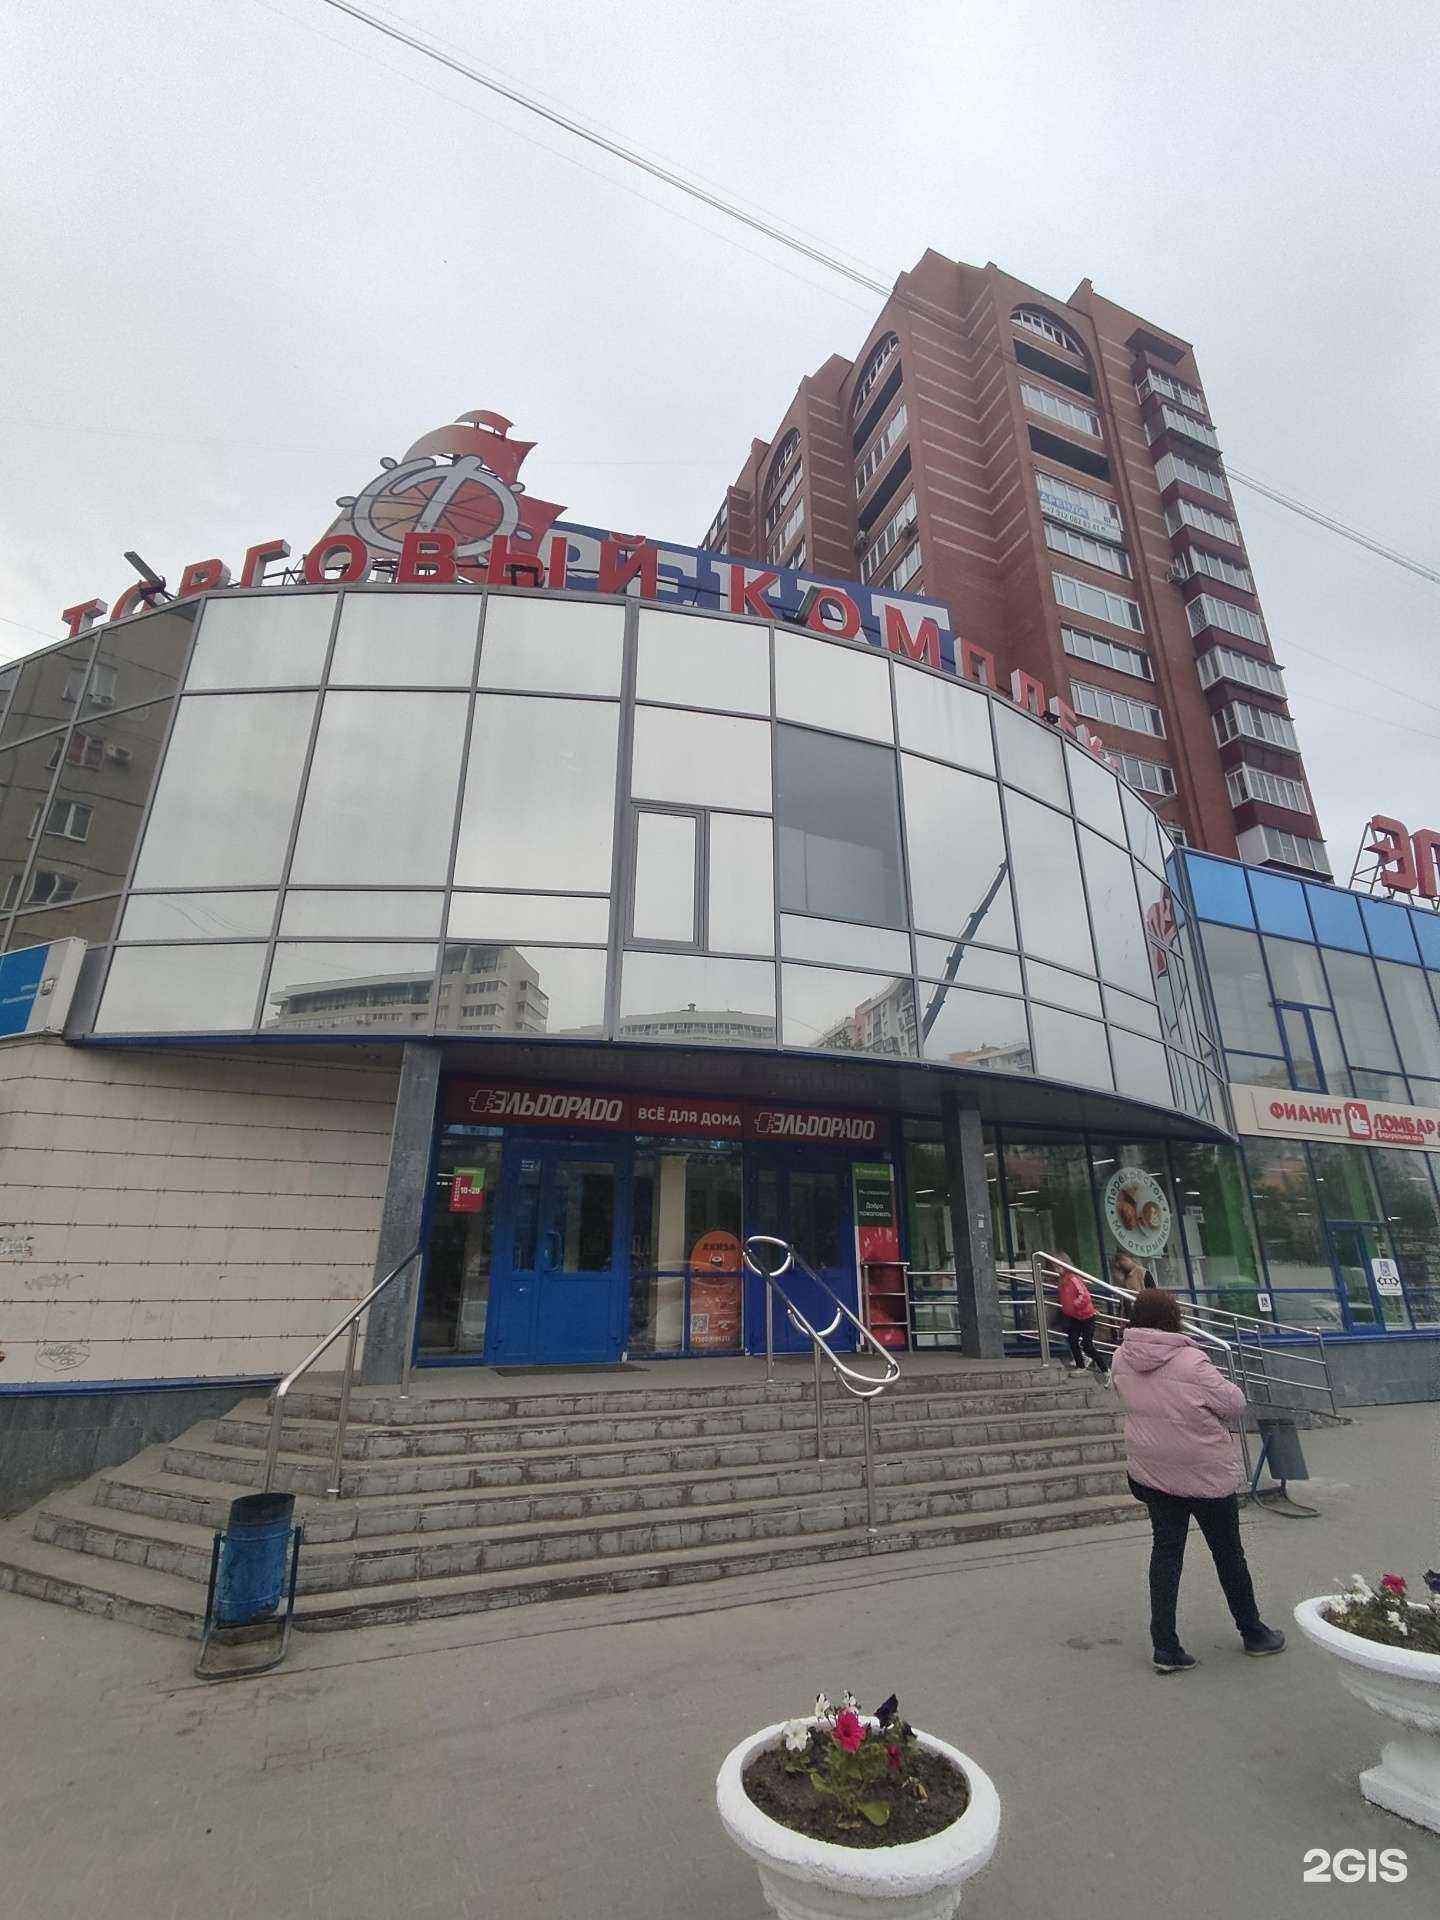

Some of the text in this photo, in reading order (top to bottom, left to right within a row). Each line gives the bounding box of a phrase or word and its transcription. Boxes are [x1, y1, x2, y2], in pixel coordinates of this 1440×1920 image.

[62, 532, 657, 638] ТОРГОВЫЙ
[638, 1106, 742, 1127] ВСЁ ДЛЯ ДОМА
[1269, 1102, 1342, 1125] ФИАНИТ
[1374, 1113, 1440, 1138] ЛОМБАР
